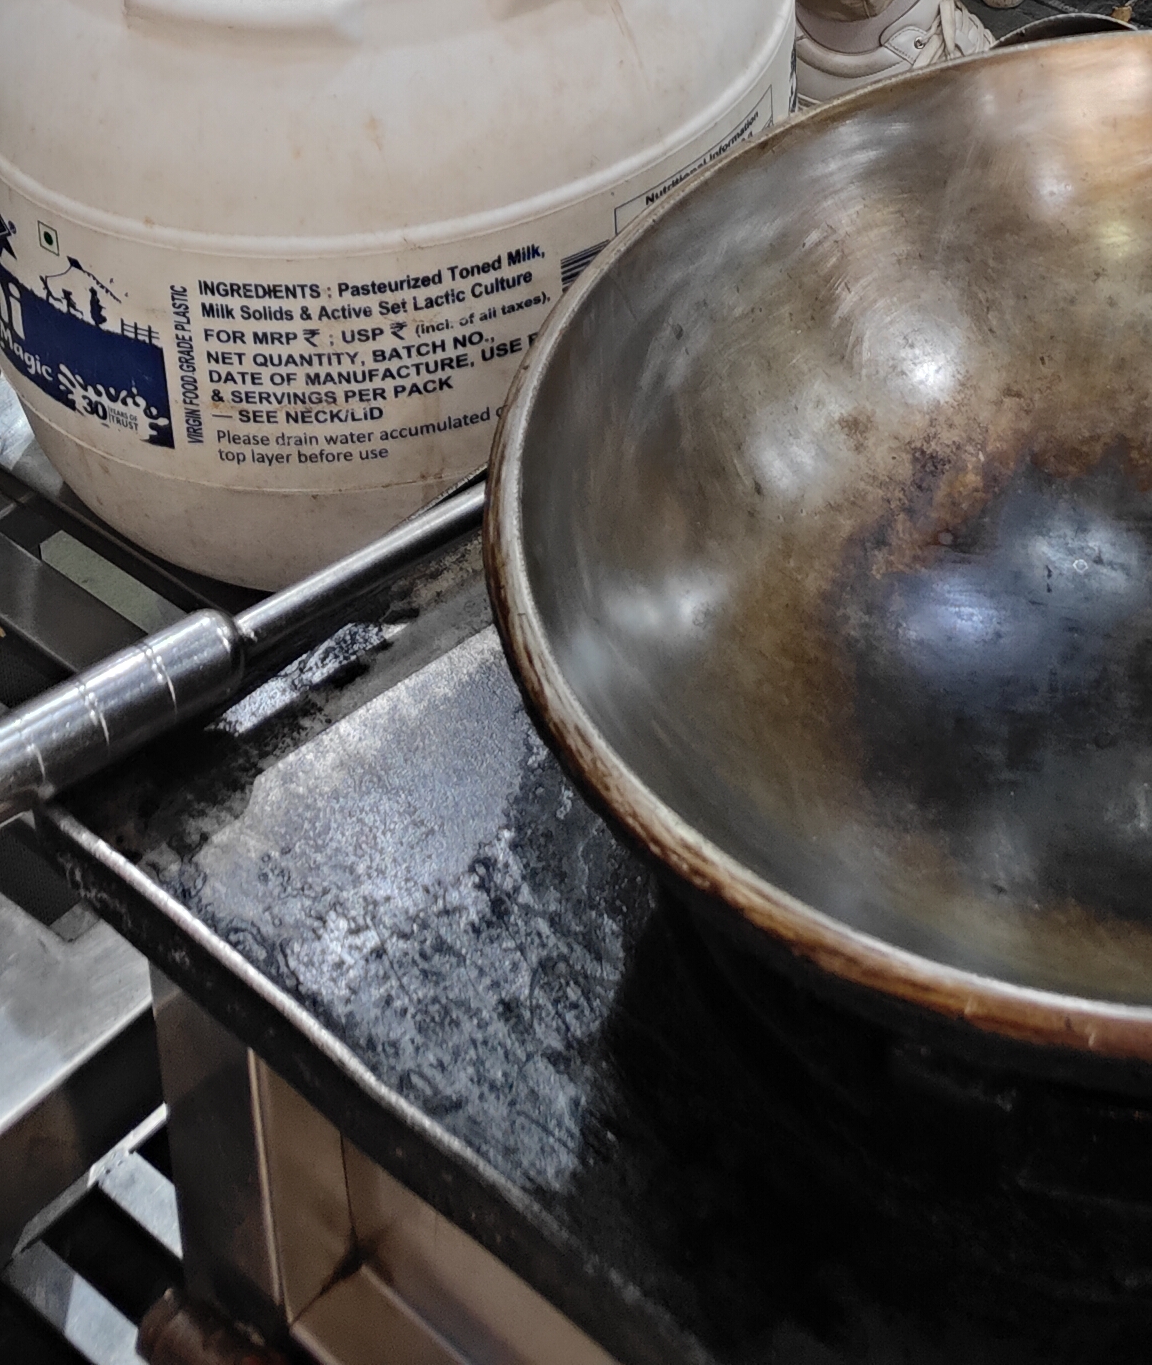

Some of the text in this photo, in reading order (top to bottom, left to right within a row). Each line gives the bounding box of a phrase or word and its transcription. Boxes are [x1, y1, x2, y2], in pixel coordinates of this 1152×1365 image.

[709, 111, 758, 161] Information
[198, 280, 321, 299] INGREDIENTS
[337, 268, 443, 298] Pasteurized
[447, 254, 502, 281] Toned
[507, 244, 545, 267] Milk,
[200, 270, 533, 321] Milk Solids & Active Set Lactic Culture
[203, 328, 247, 345] FOR
[252, 331, 298, 346] MRP
[303, 328, 320, 348] ₹
[341, 327, 384, 344] USP
[390, 321, 408, 341] ₹
[415, 319, 454, 338] (incl.
[459, 312, 475, 326] of
[479, 307, 497, 322] all
[501, 291, 551, 315] taxes),
[0, 321, 53, 381] Magic
[169, 285, 204, 444] VIRGIN FOOD GRADE PLASTIC
[206, 331, 495, 368] NET QUANTITY, BATCH NO.,
[208, 369, 264, 386] DATE
[269, 372, 298, 386] OF
[305, 353, 475, 387] MANUFACTURE,
[481, 337, 523, 362] USE
[81, 394, 108, 420] 30
[129, 413, 138, 422] OF
[211, 375, 453, 406] & SERVINGS PER PACK
[111, 415, 139, 431] TRUST
[216, 429, 270, 447] Please
[275, 431, 319, 447] drain
[324, 430, 374, 446] water
[379, 406, 490, 442] accumulated
[238, 409, 279, 424] SEE
[218, 447, 389, 467] top layer before use
